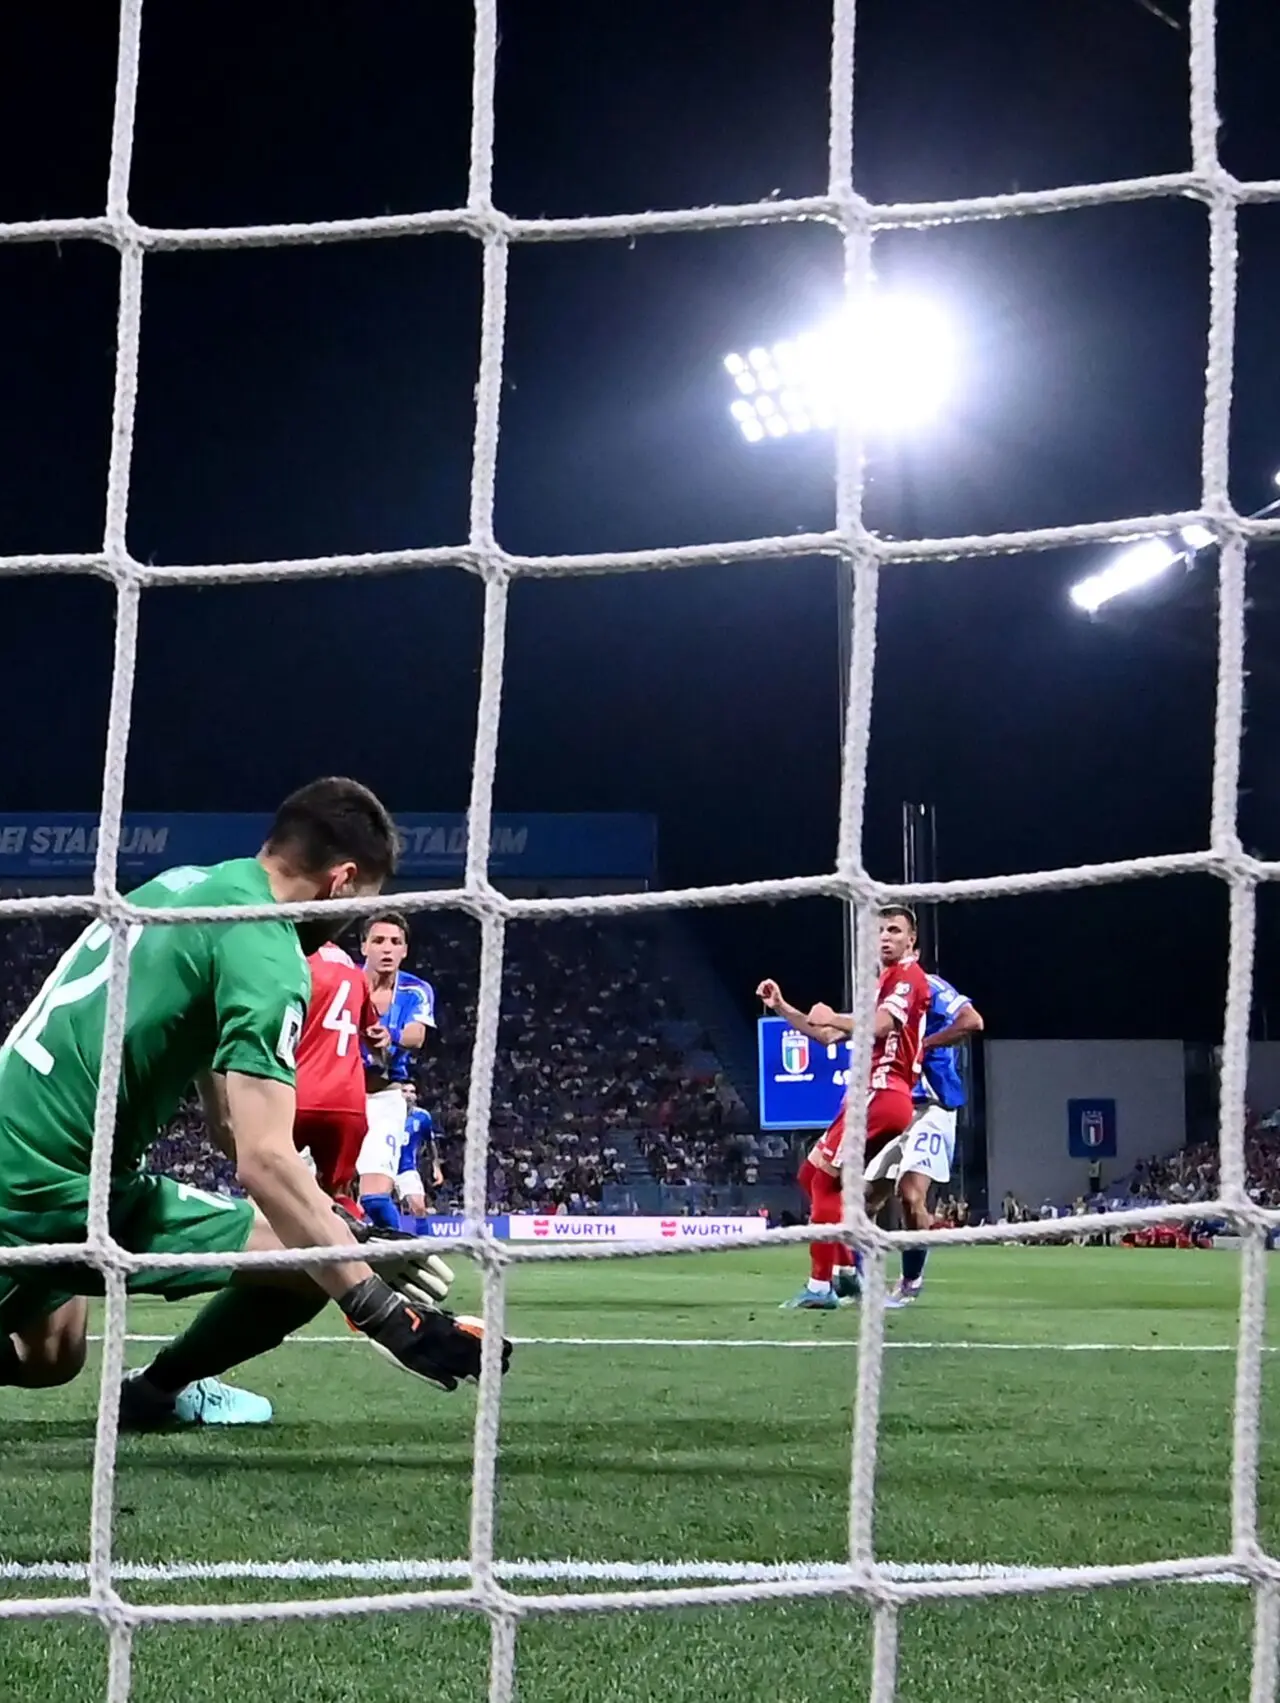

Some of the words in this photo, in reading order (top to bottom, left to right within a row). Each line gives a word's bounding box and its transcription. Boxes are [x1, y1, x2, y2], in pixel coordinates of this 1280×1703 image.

[30, 826, 168, 854] STAUM
[322, 980, 357, 1057] 4
[385, 1134, 397, 1156] 9
[914, 1132, 942, 1155] 20
